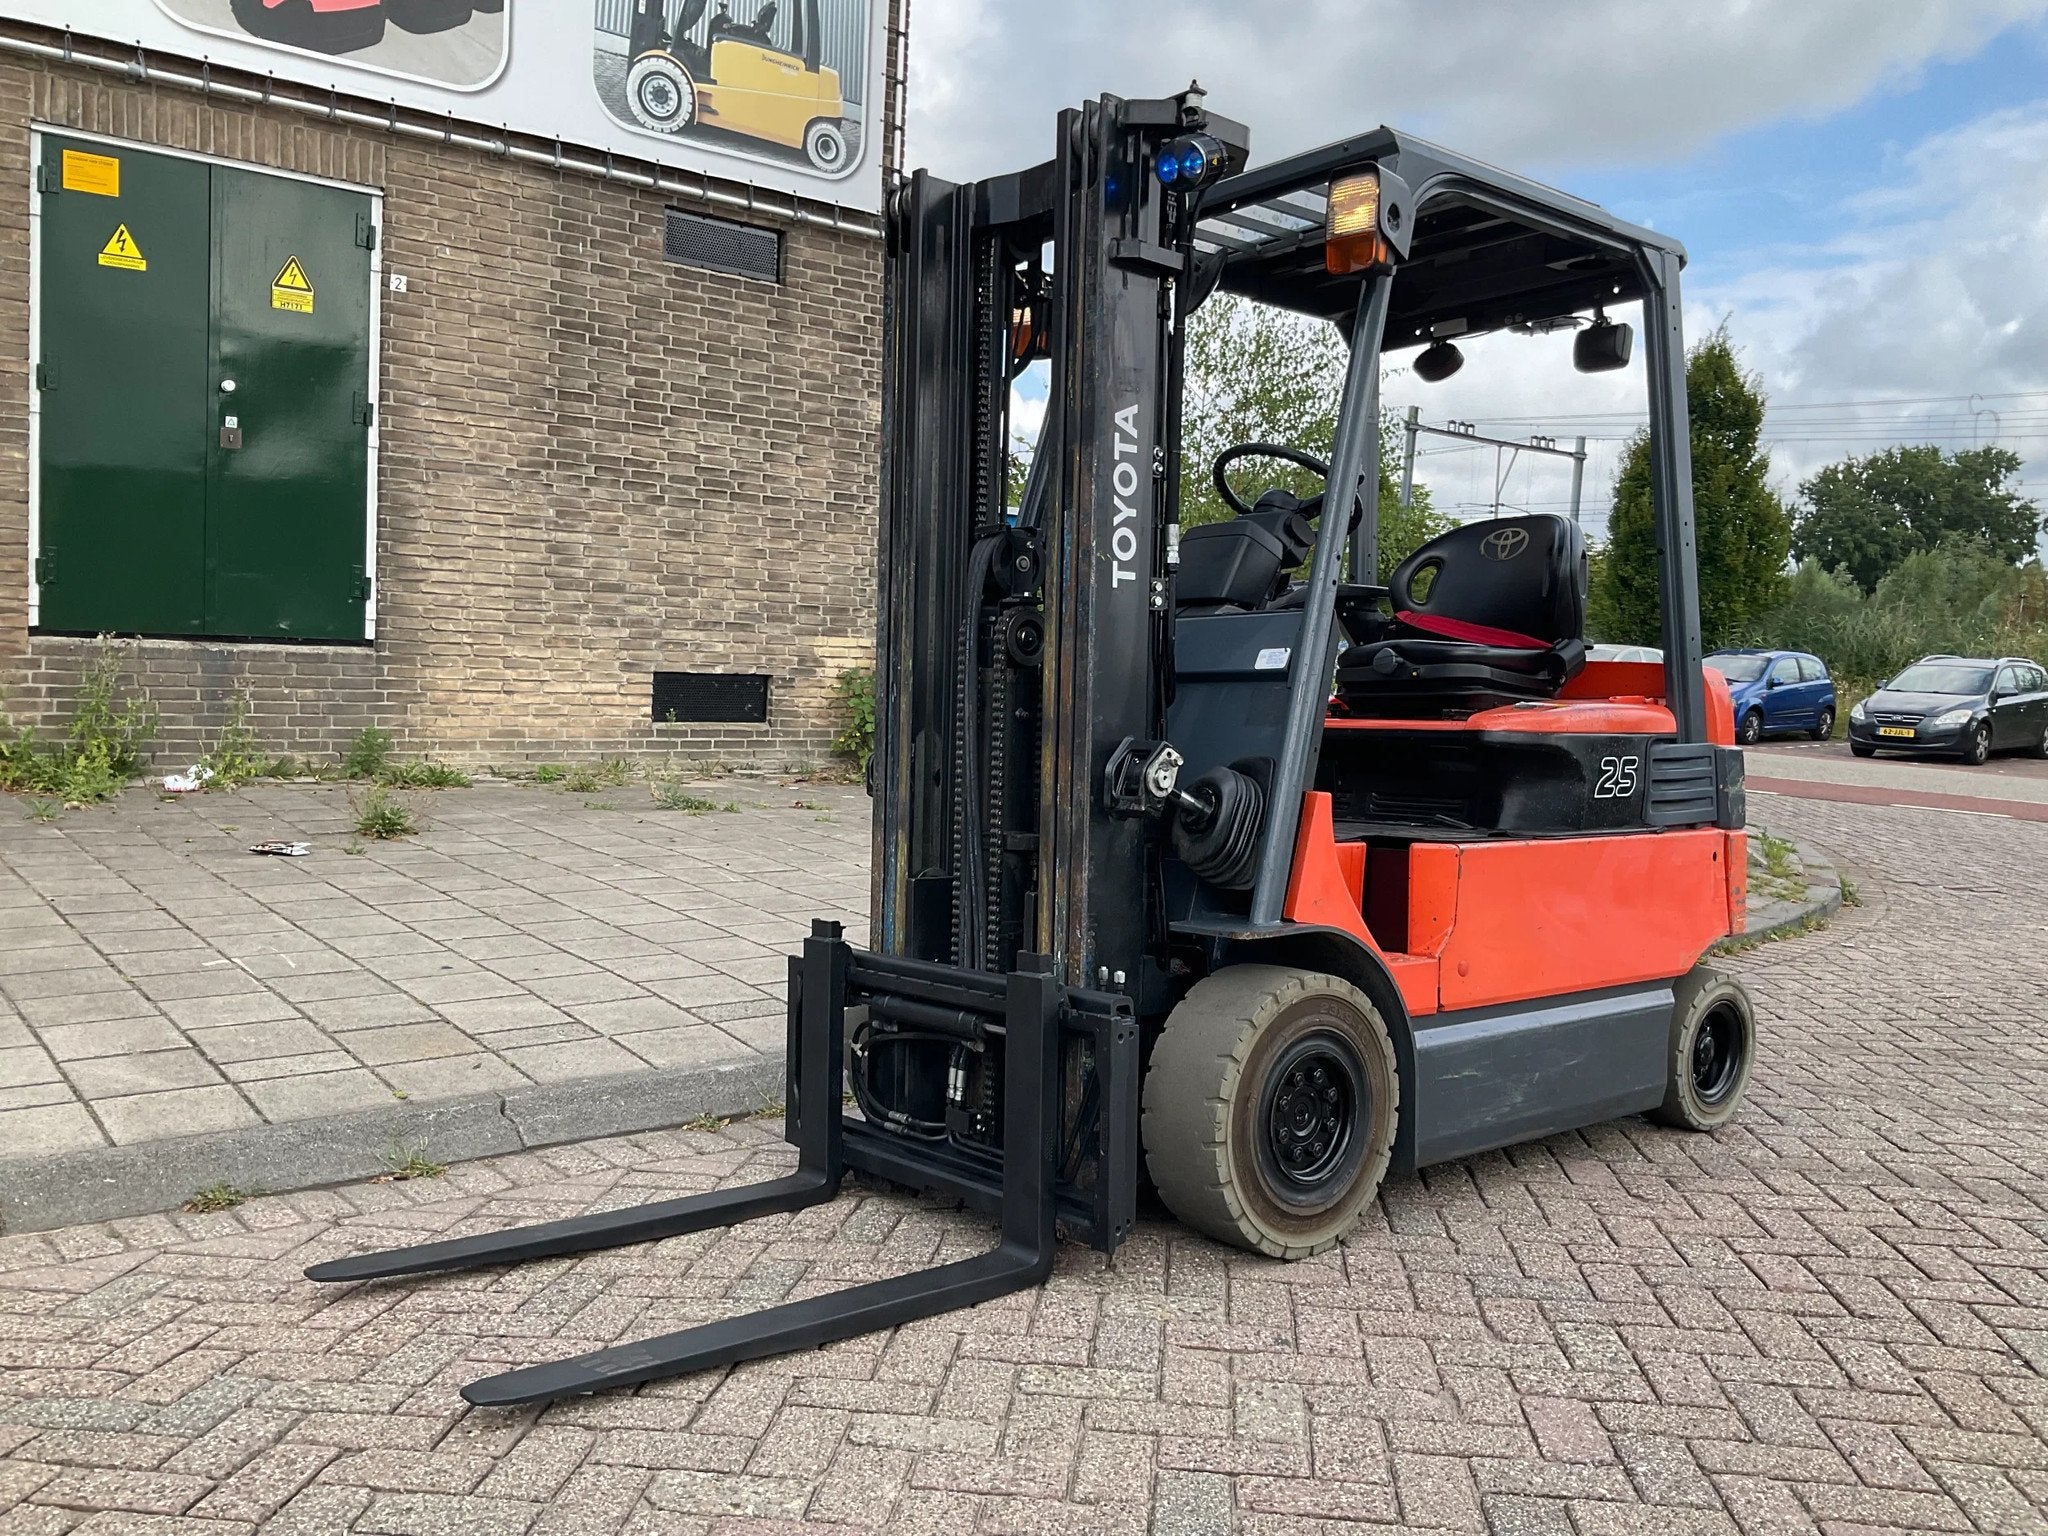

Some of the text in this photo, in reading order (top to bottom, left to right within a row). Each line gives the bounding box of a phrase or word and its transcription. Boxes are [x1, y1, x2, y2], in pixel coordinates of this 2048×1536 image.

[394, 276, 403, 291] 2
[1112, 404, 1139, 589] TOYOTA
[1594, 756, 1639, 798] 25
